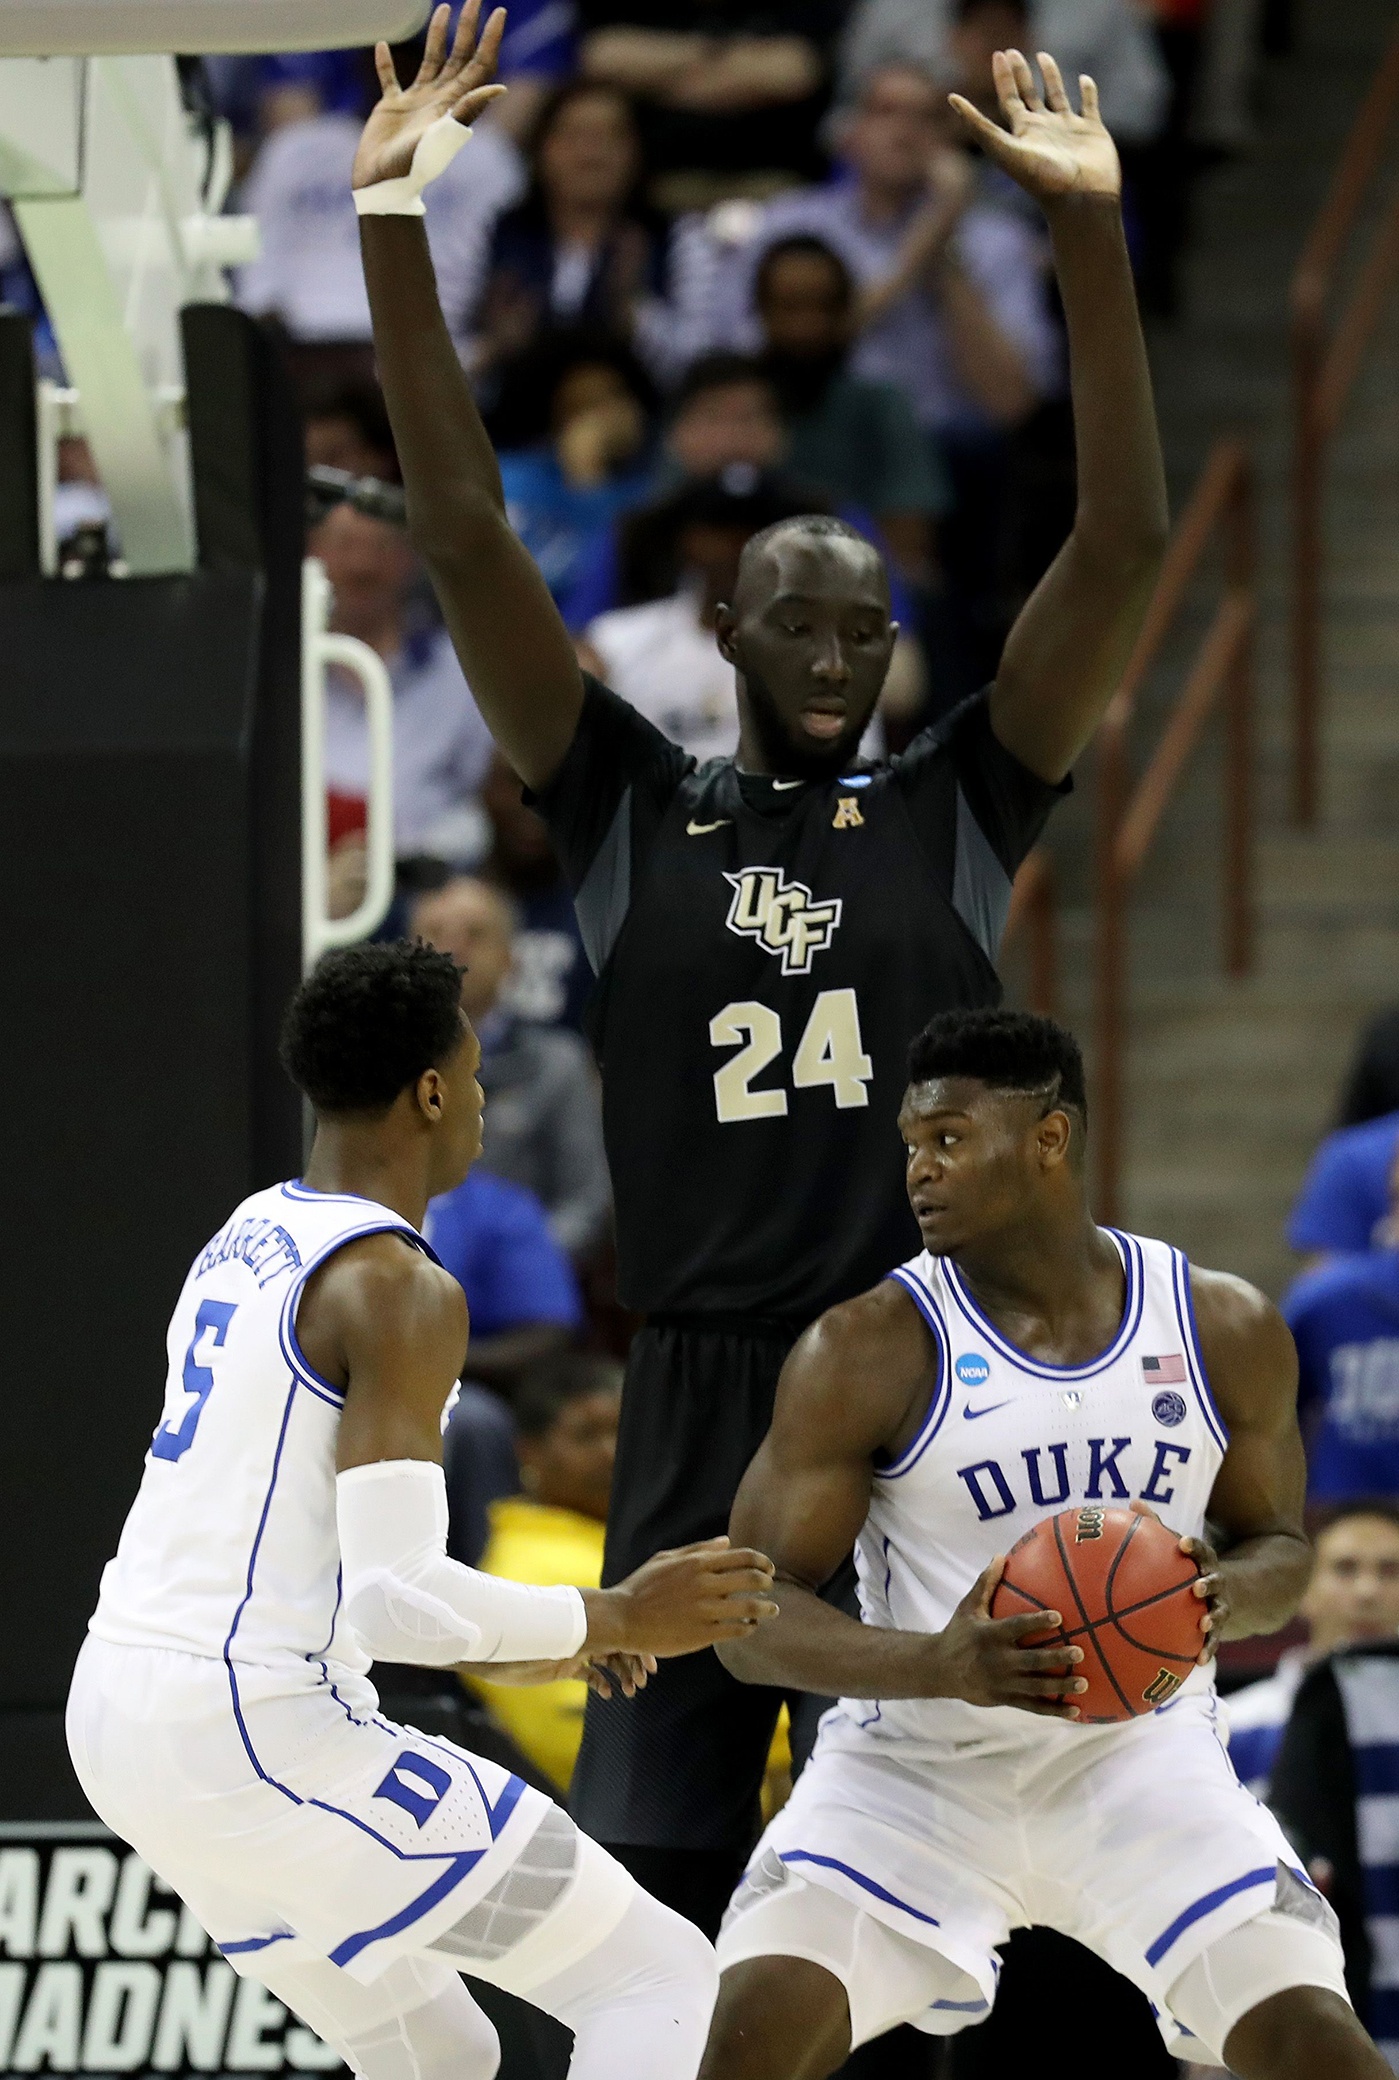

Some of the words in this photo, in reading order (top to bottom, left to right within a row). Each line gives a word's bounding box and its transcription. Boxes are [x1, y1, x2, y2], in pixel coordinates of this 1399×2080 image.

[722, 866, 842, 976] UCF
[709, 988, 873, 1123] 24
[195, 1217, 302, 1290] BARRETT
[151, 1299, 238, 1463] 5
[957, 1437, 1192, 1522] DUKE
[372, 1751, 452, 1830] D
